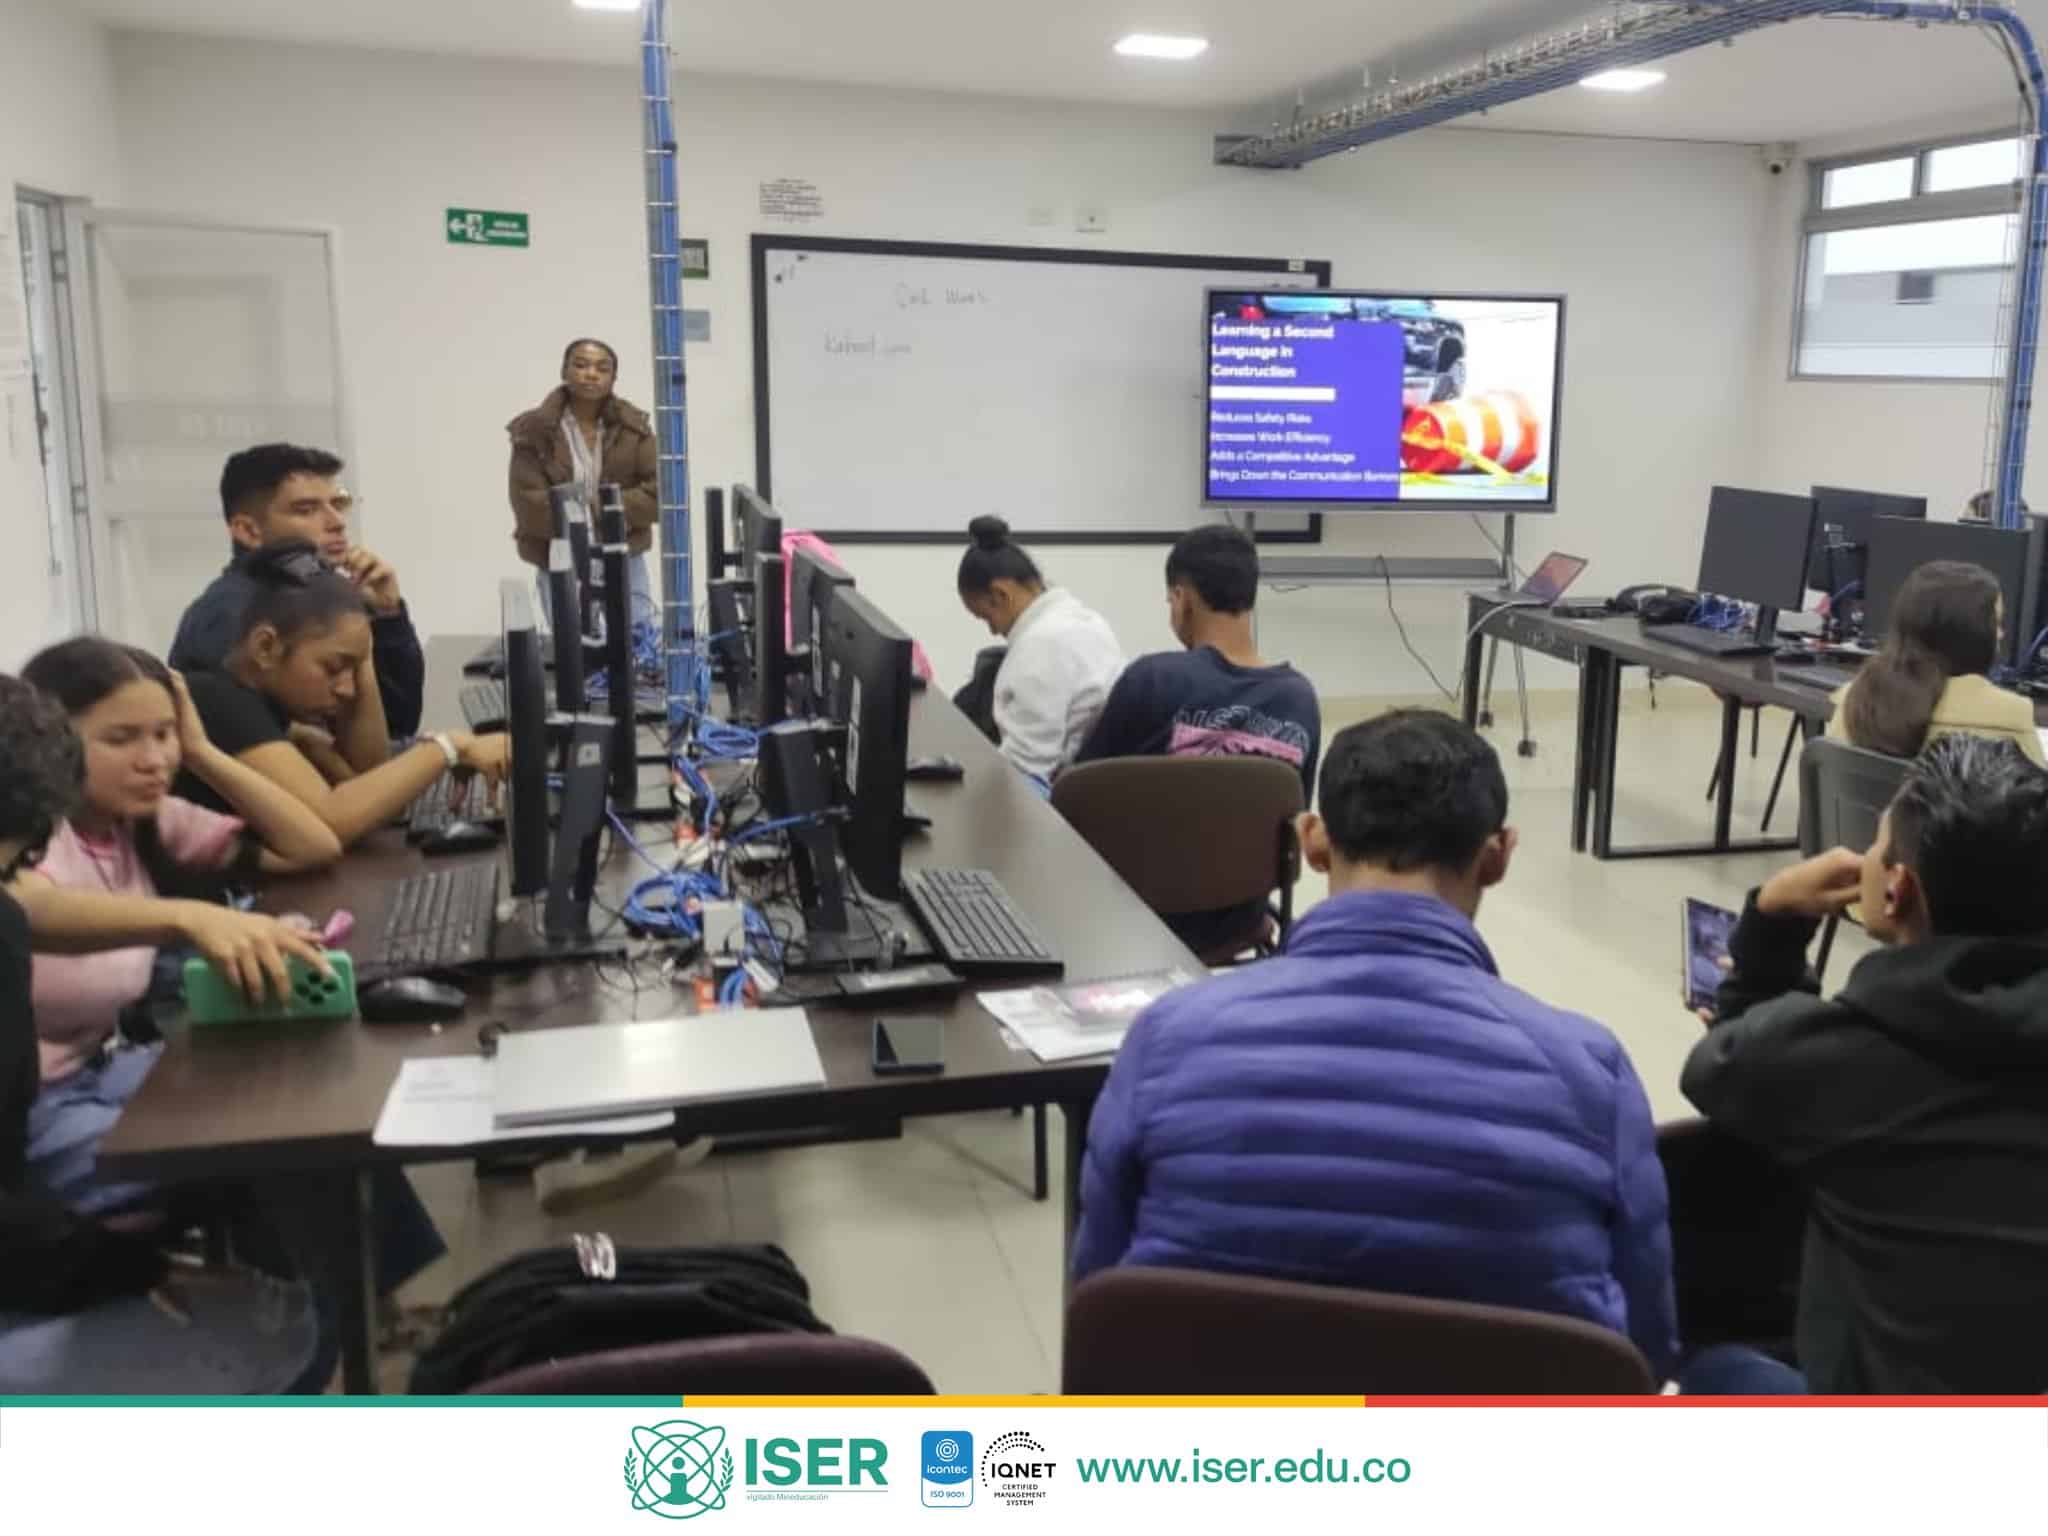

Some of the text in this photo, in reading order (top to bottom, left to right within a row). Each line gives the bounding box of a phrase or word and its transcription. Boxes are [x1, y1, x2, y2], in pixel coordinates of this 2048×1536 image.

[1212, 322, 1335, 340] Learning a Second
[1212, 343, 1294, 360] Language in
[1212, 364, 1297, 379] Construction
